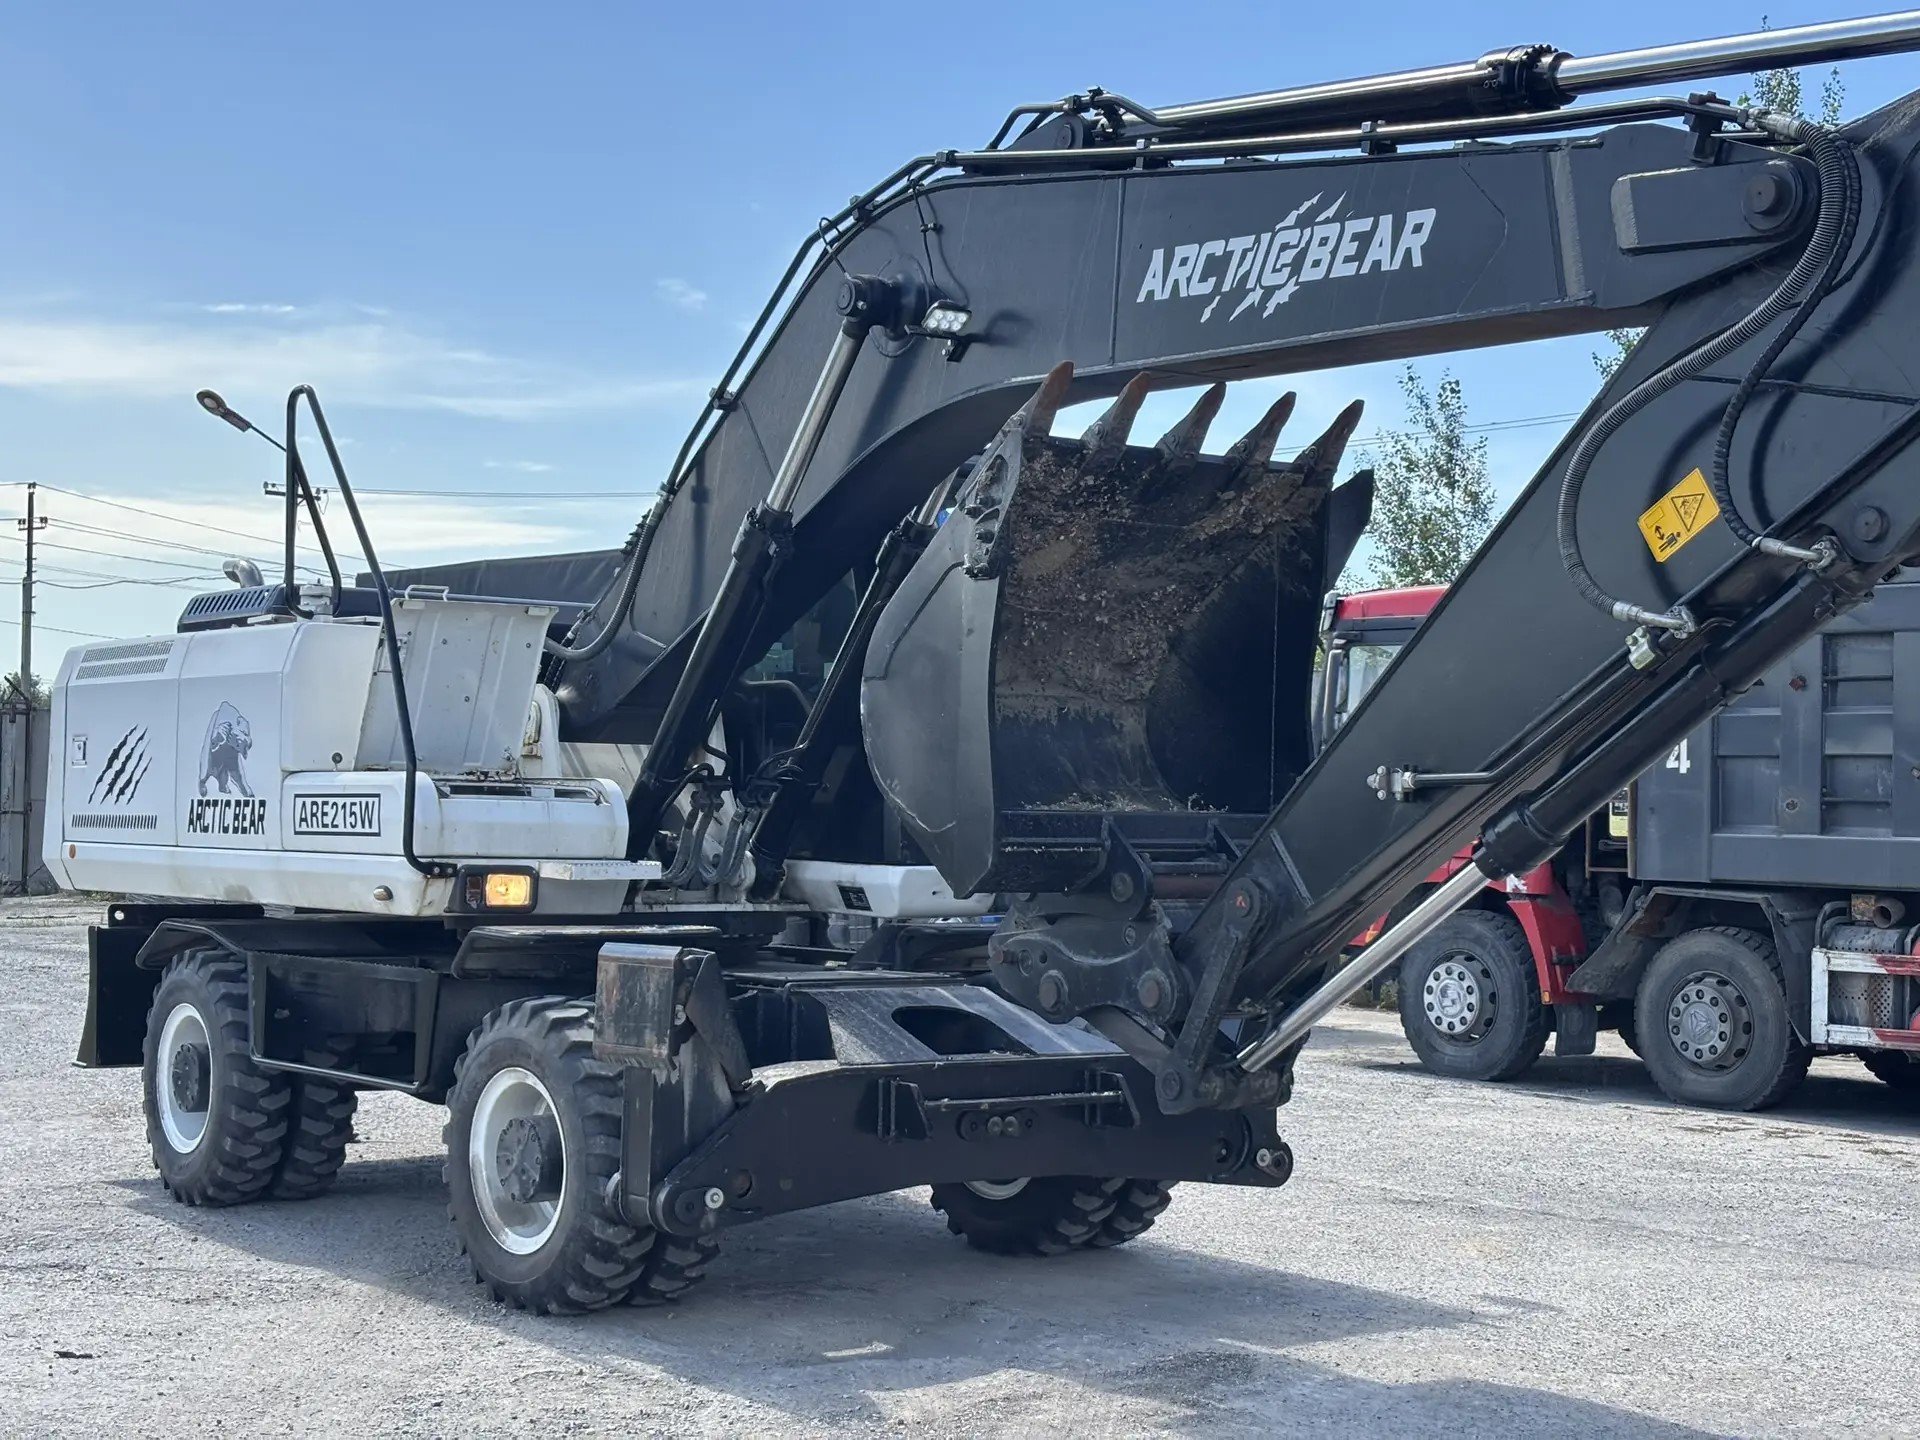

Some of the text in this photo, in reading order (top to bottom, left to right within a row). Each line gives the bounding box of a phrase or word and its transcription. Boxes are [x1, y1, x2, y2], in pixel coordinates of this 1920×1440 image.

[1136, 208, 1436, 303] ARCTIC BEAR
[188, 799, 266, 835] ARCTIC BEAR
[299, 800, 375, 829] ARE215W
